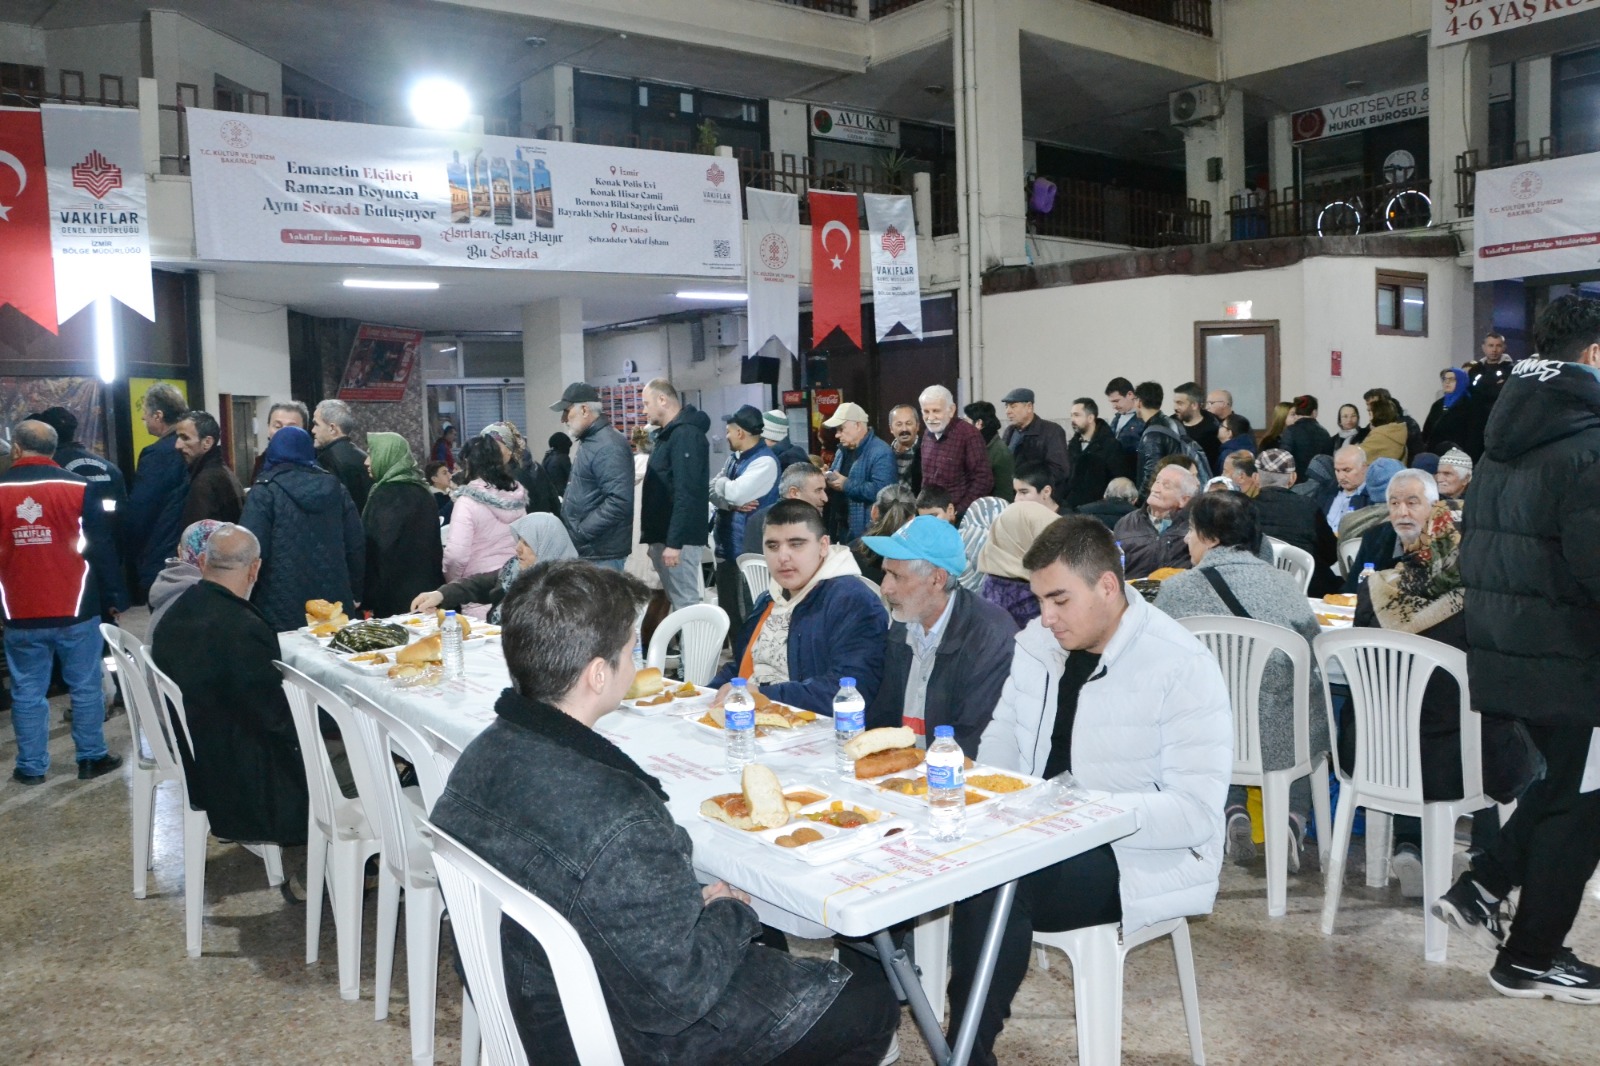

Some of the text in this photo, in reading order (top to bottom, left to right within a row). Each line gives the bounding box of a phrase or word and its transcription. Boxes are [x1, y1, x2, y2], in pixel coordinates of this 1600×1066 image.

[1446, 10, 1483, 36] 4-6
[1488, 0, 1537, 26] YAŞ
[1329, 90, 1417, 119] YURTSEVER
[837, 112, 893, 131] AVUKAT
[1329, 117, 1367, 132] HUKUK
[287, 161, 413, 183] Emanetin Elçileri
[285, 179, 419, 202] Ramazan Boyunca
[595, 178, 656, 190] Konak Polis Evi
[590, 188, 663, 200] Konak Hisar Camii
[263, 197, 437, 222] Aynı Sofrada Buluşuyor
[575, 198, 679, 212] Bornova Bilal Saygılı Camii
[60, 211, 139, 225] VAKIFLAR
[558, 208, 591, 218] Bayraklı
[616, 212, 653, 221] Hastanesi
[654, 212, 672, 222] İftar
[673, 215, 696, 224] Çadırı
[62, 225, 139, 234] GENEL MÜDÜRLÜĞÜ
[440, 227, 564, 246] Asırları Aşan Hayır
[621, 225, 648, 233] Manisa
[629, 237, 647, 245] Vakıf
[467, 244, 539, 260] Bu Sofrada
[876, 266, 914, 275] VAKIFLAR
[12, 529, 51, 539] VAKIFLAR
